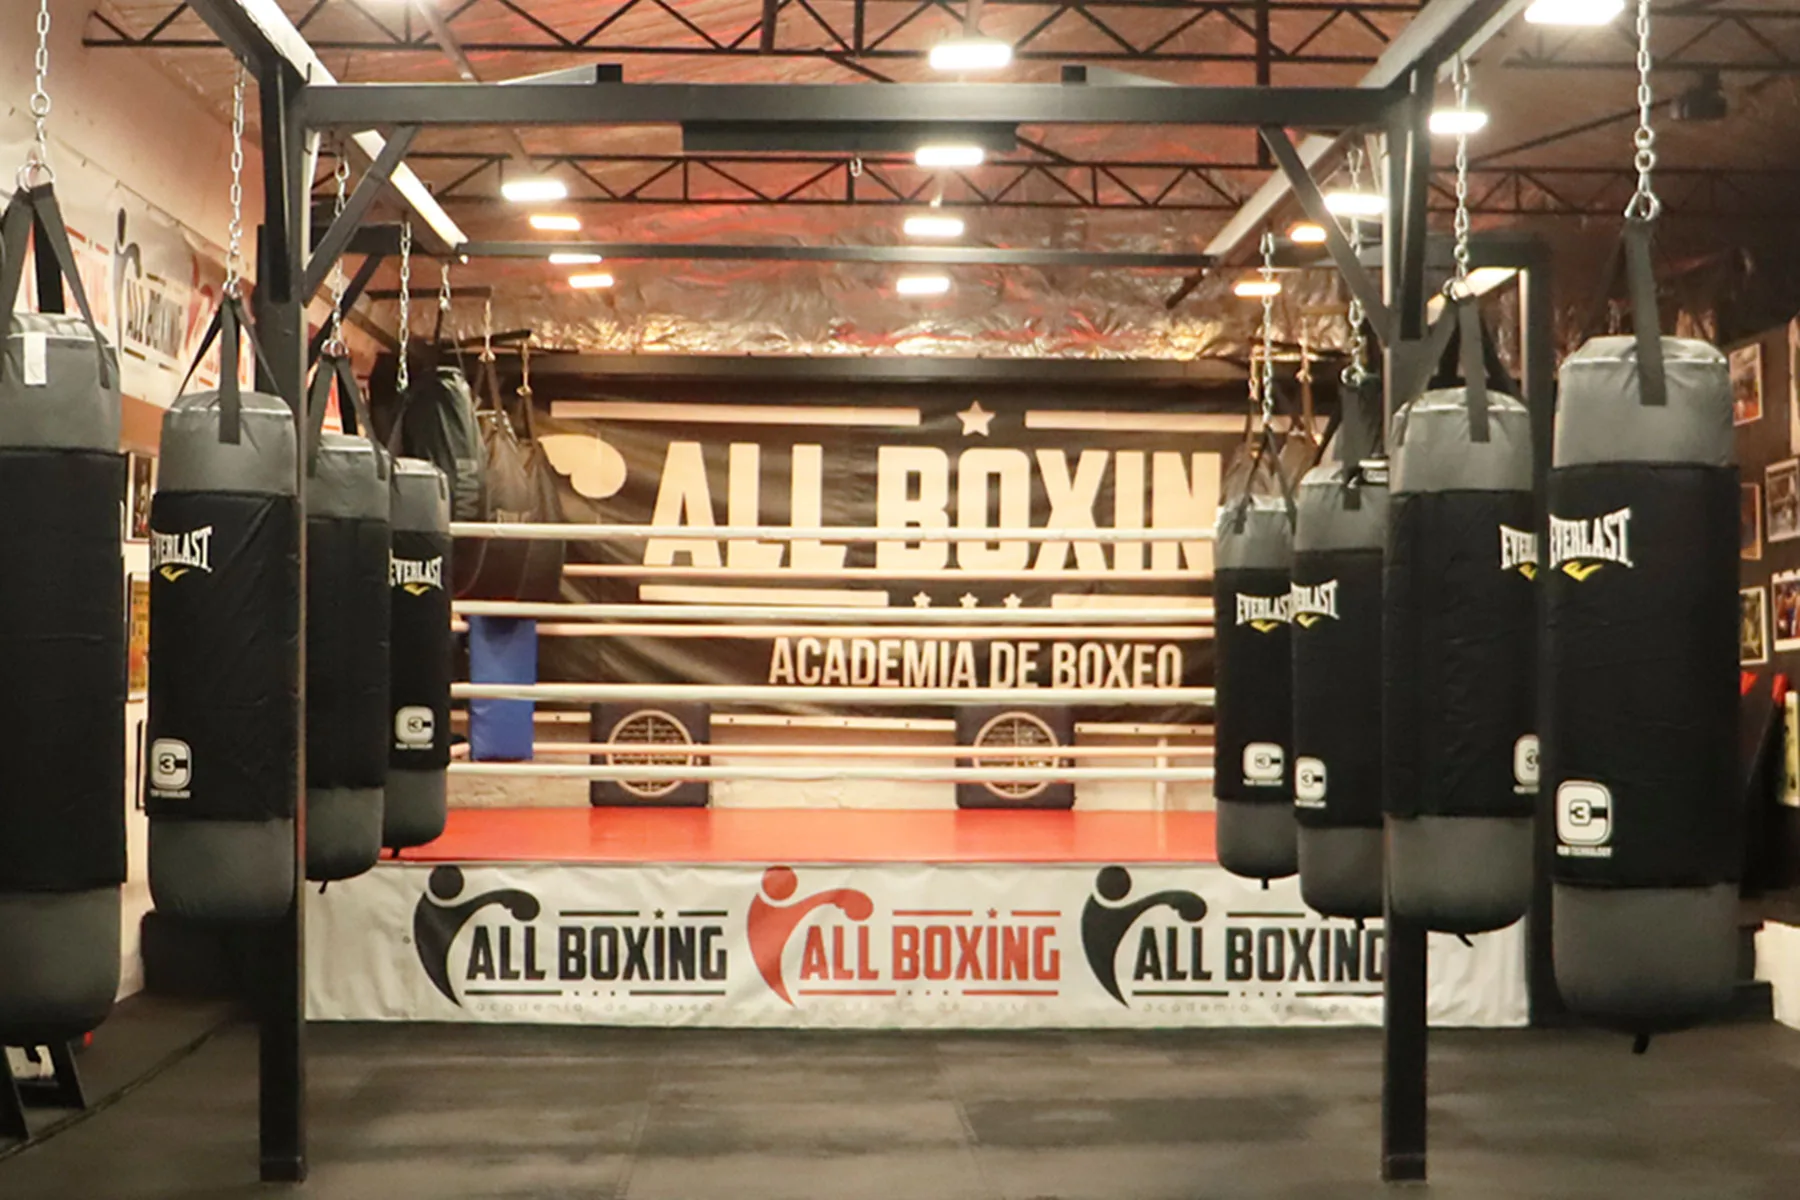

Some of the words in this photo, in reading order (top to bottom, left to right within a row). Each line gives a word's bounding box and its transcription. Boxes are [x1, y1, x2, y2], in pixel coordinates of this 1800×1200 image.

[643, 441, 847, 570] ALL
[875, 445, 1222, 572] BOXIN
[151, 526, 212, 572] EVERLAST
[1549, 507, 1634, 569] EVERLAST
[769, 637, 976, 688] ACADEMIA
[989, 641, 1040, 689] DE
[1052, 642, 1182, 689] BOXEO
[466, 926, 546, 980] ALL
[558, 926, 727, 981] BOXING
[799, 925, 880, 980] ALL
[892, 925, 1060, 981] BOXING
[1134, 927, 1212, 981] ALL
